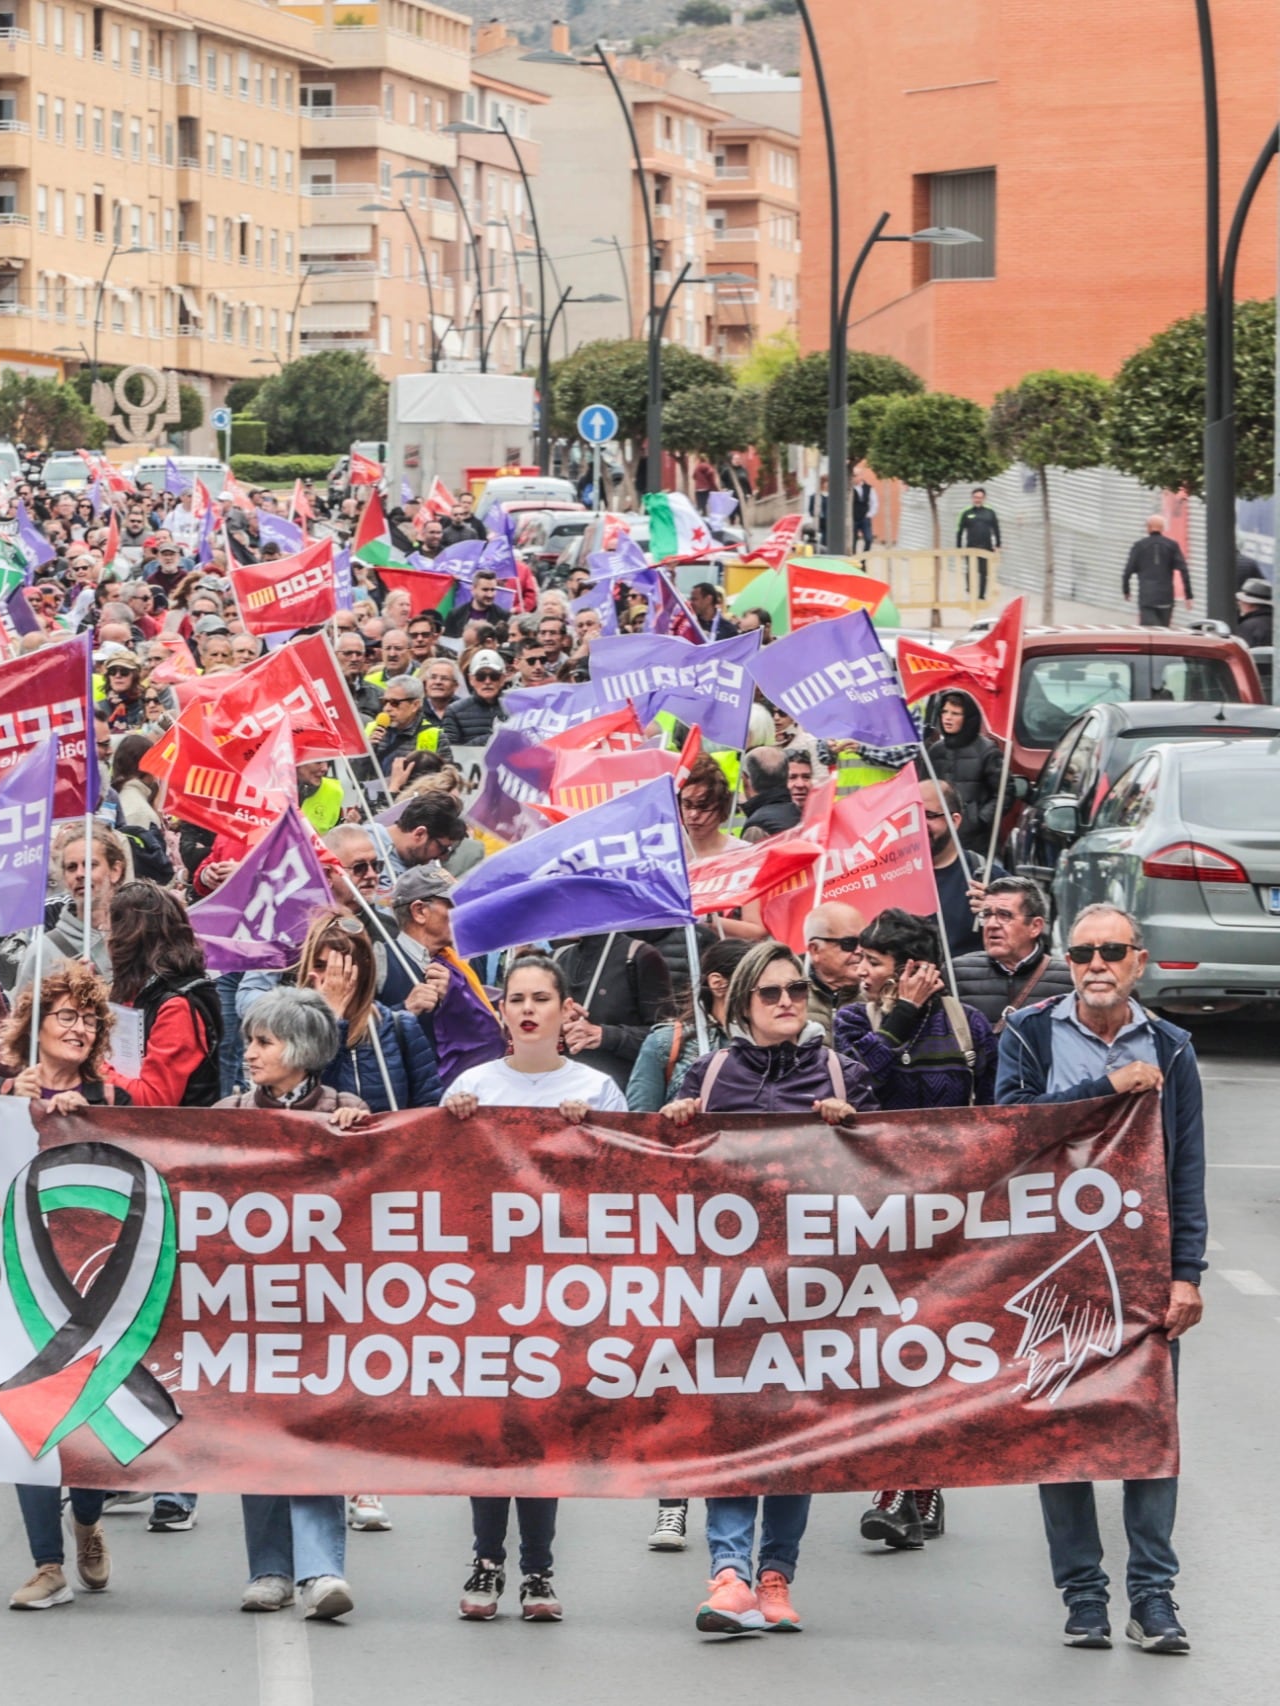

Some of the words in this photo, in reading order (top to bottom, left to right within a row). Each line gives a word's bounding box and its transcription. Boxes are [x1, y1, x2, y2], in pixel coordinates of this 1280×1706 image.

[179, 1190, 347, 1255] POR
[370, 1190, 469, 1253] EL
[491, 1191, 760, 1256] PLENO
[786, 1167, 1144, 1256] EMPLEO:
[180, 1262, 477, 1327] MENOS
[498, 1263, 919, 1328] JORNADA,
[181, 1332, 562, 1399] MEJORES
[586, 1322, 1000, 1399] SALARIOS
